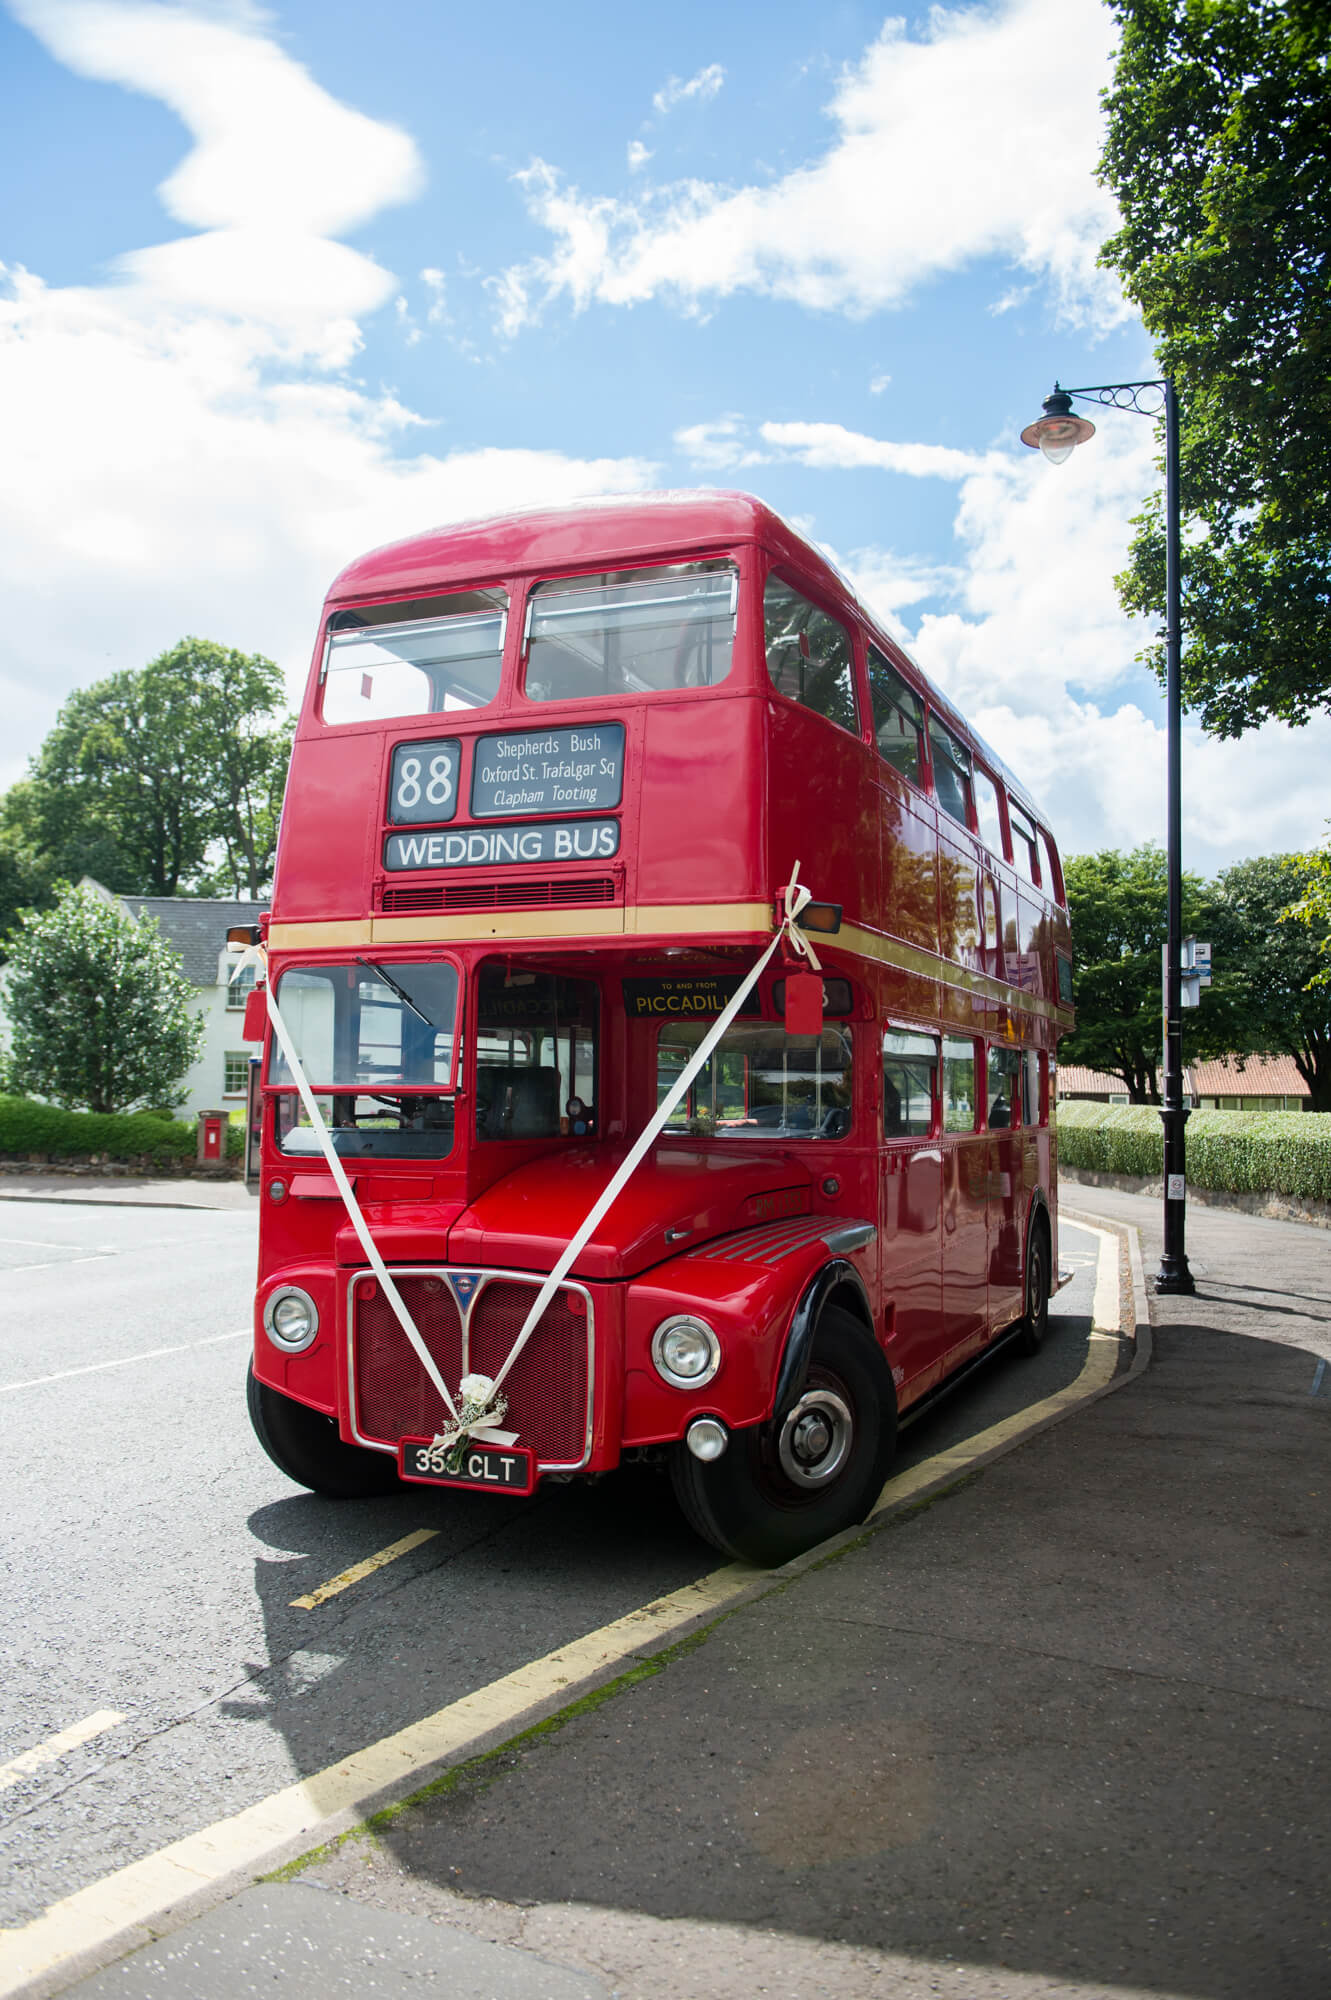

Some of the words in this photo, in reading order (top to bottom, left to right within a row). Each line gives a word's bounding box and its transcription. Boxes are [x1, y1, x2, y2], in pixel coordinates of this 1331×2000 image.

[496, 735, 560, 760] Shepherds
[570, 733, 601, 752] Bush
[397, 755, 452, 808] 88
[481, 764, 519, 783] Oxford
[522, 763, 538, 780] St.
[541, 761, 596, 781] Trafalgar
[600, 758, 615, 778] Sq
[494, 789, 544, 807] Clapham
[552, 785, 597, 802] Tooting
[398, 832, 543, 866] WEDDING
[554, 827, 615, 858] BUS
[696, 981, 717, 989] FROM
[636, 994, 730, 1013] PICCADILL
[468, 1455, 516, 1481] CLT
